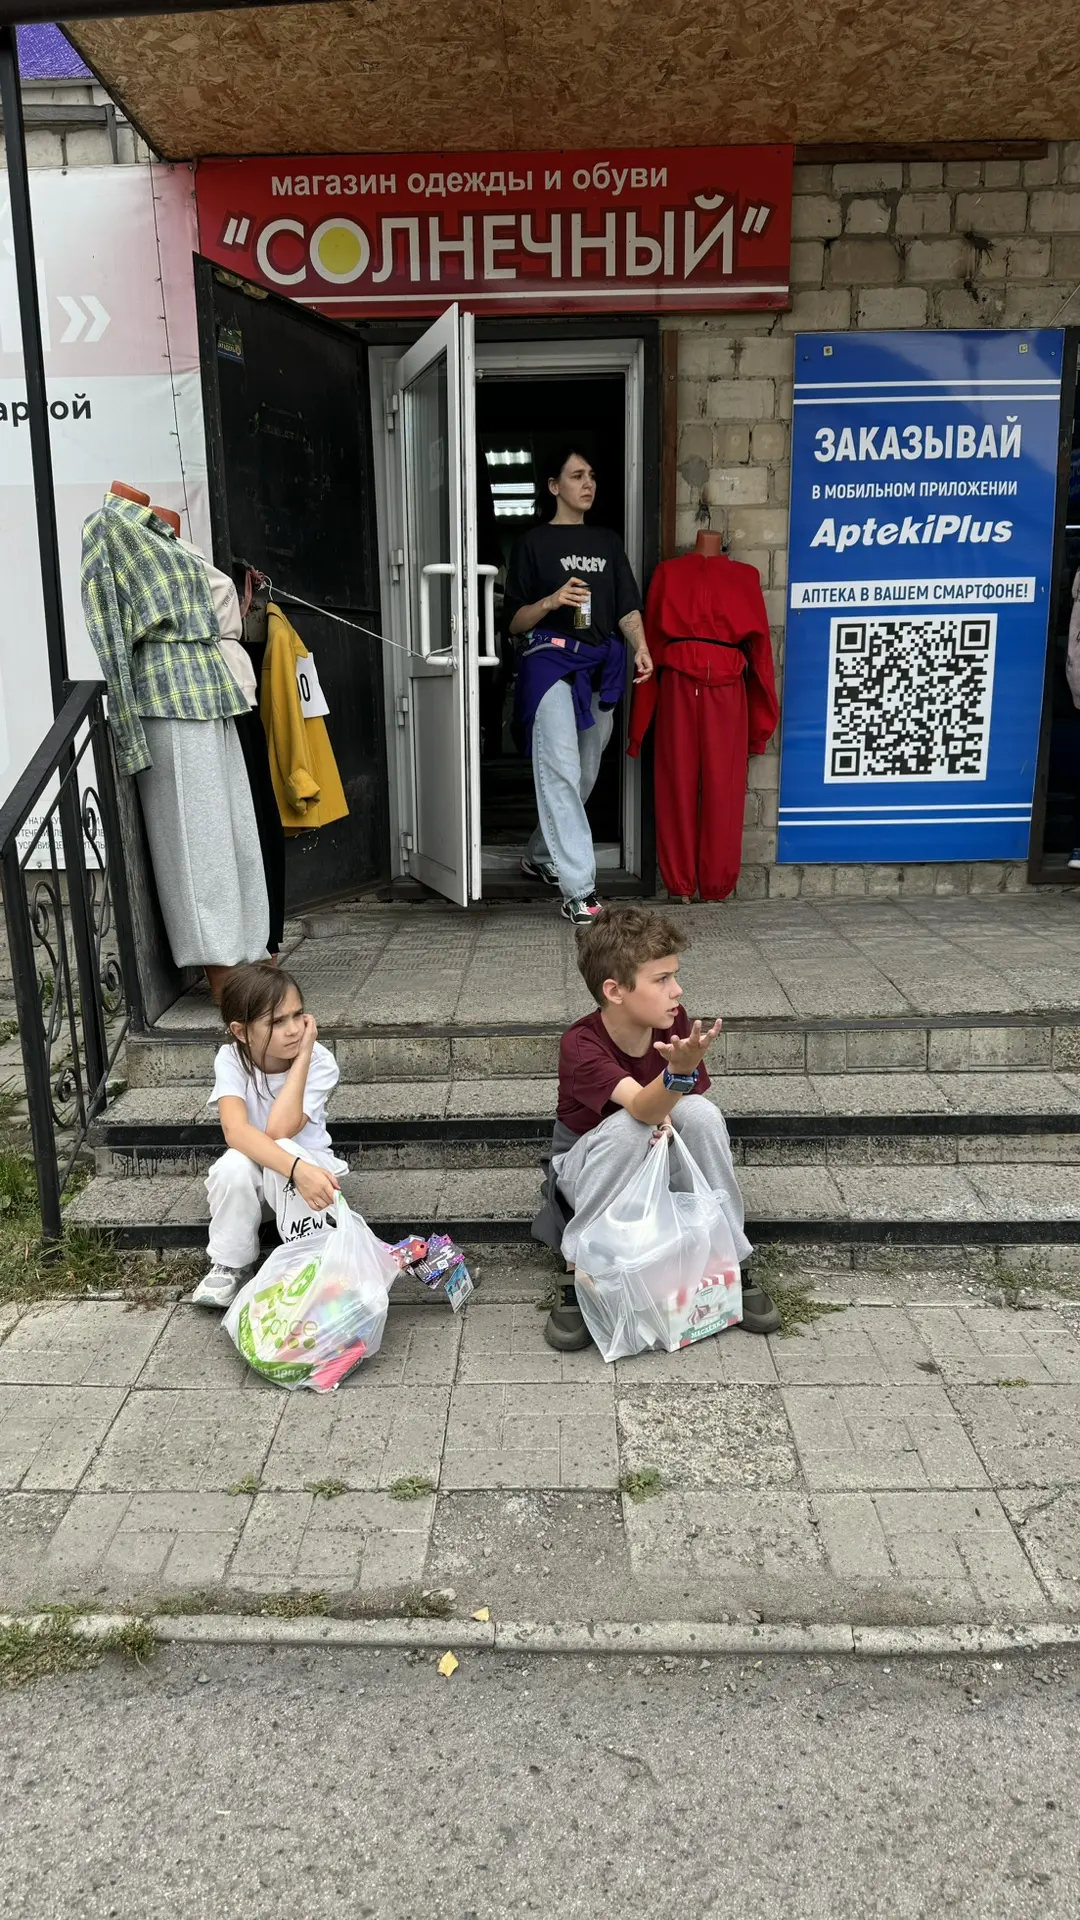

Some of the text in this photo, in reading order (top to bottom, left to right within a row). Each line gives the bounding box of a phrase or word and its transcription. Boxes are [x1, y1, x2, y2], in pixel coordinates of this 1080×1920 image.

[271, 161, 668, 198] магазин одежды и обуви
[0, 393, 91, 427] арой
[814, 415, 1022, 462] ЗАКАЗЫВАЙ
[812, 481, 1018, 500] В МОБИЛЬНОМ ПРИЛОЖЕНИИ
[810, 514, 1013, 552] AptekiPlus
[560, 554, 607, 572] MICKEY
[801, 583, 1028, 603] АПТЕКА В ВАШЕМ СМАРТФОНЕ!
[290, 1216, 324, 1235] NEW
